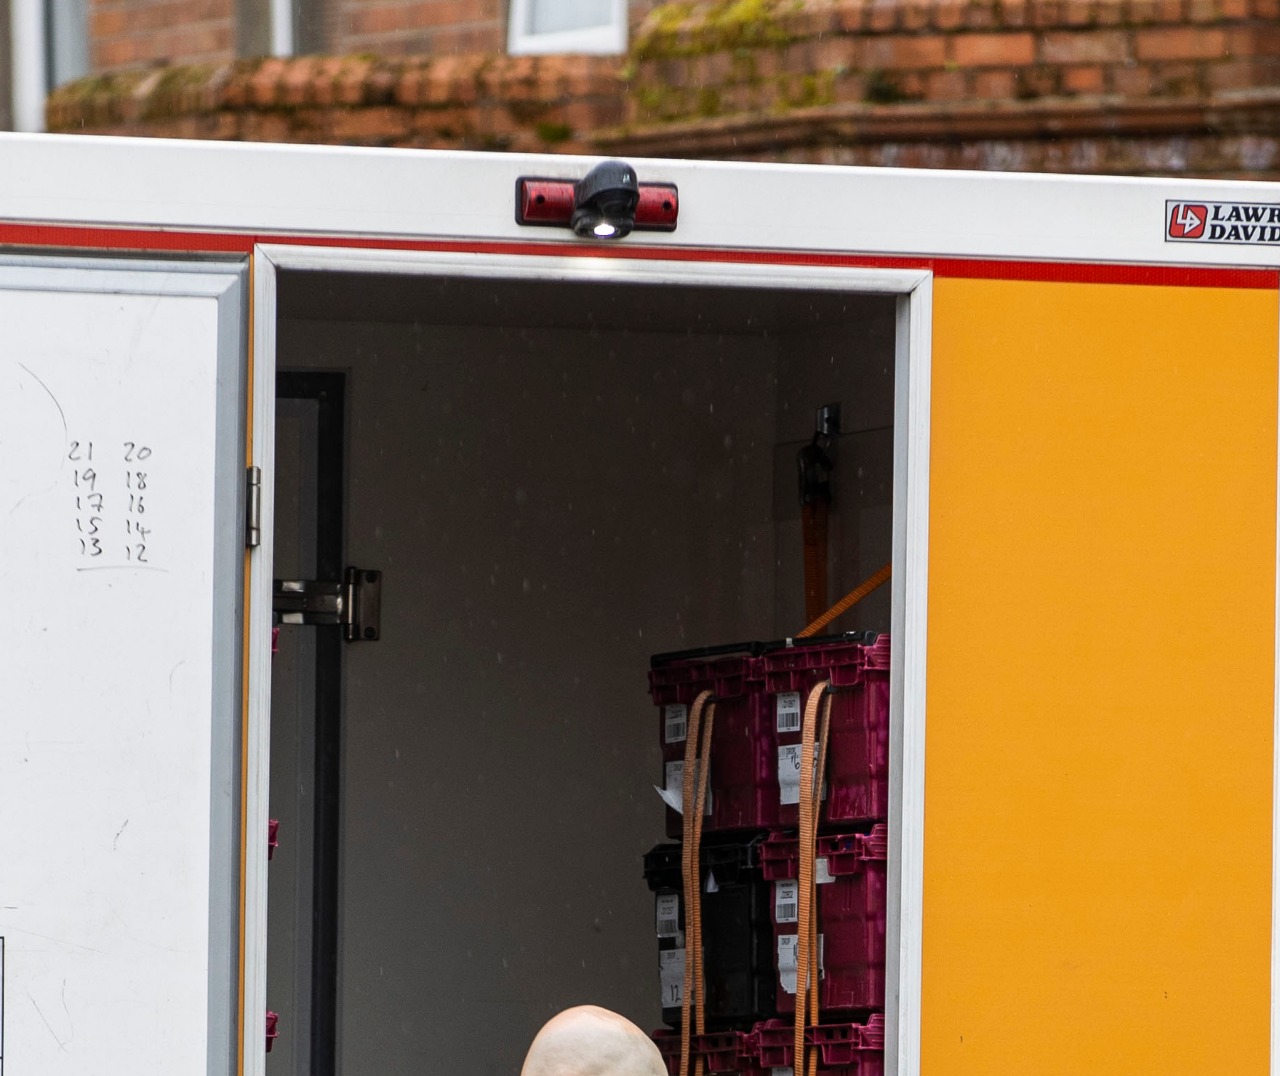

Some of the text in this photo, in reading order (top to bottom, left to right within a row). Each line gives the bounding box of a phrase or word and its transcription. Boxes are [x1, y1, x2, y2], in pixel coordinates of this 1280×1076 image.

[68, 440, 152, 462] 21 20
[75, 468, 147, 491] 19 18
[77, 492, 144, 514] 17 16
[76, 516, 151, 541] 15 14
[80, 538, 148, 562] 13 12
